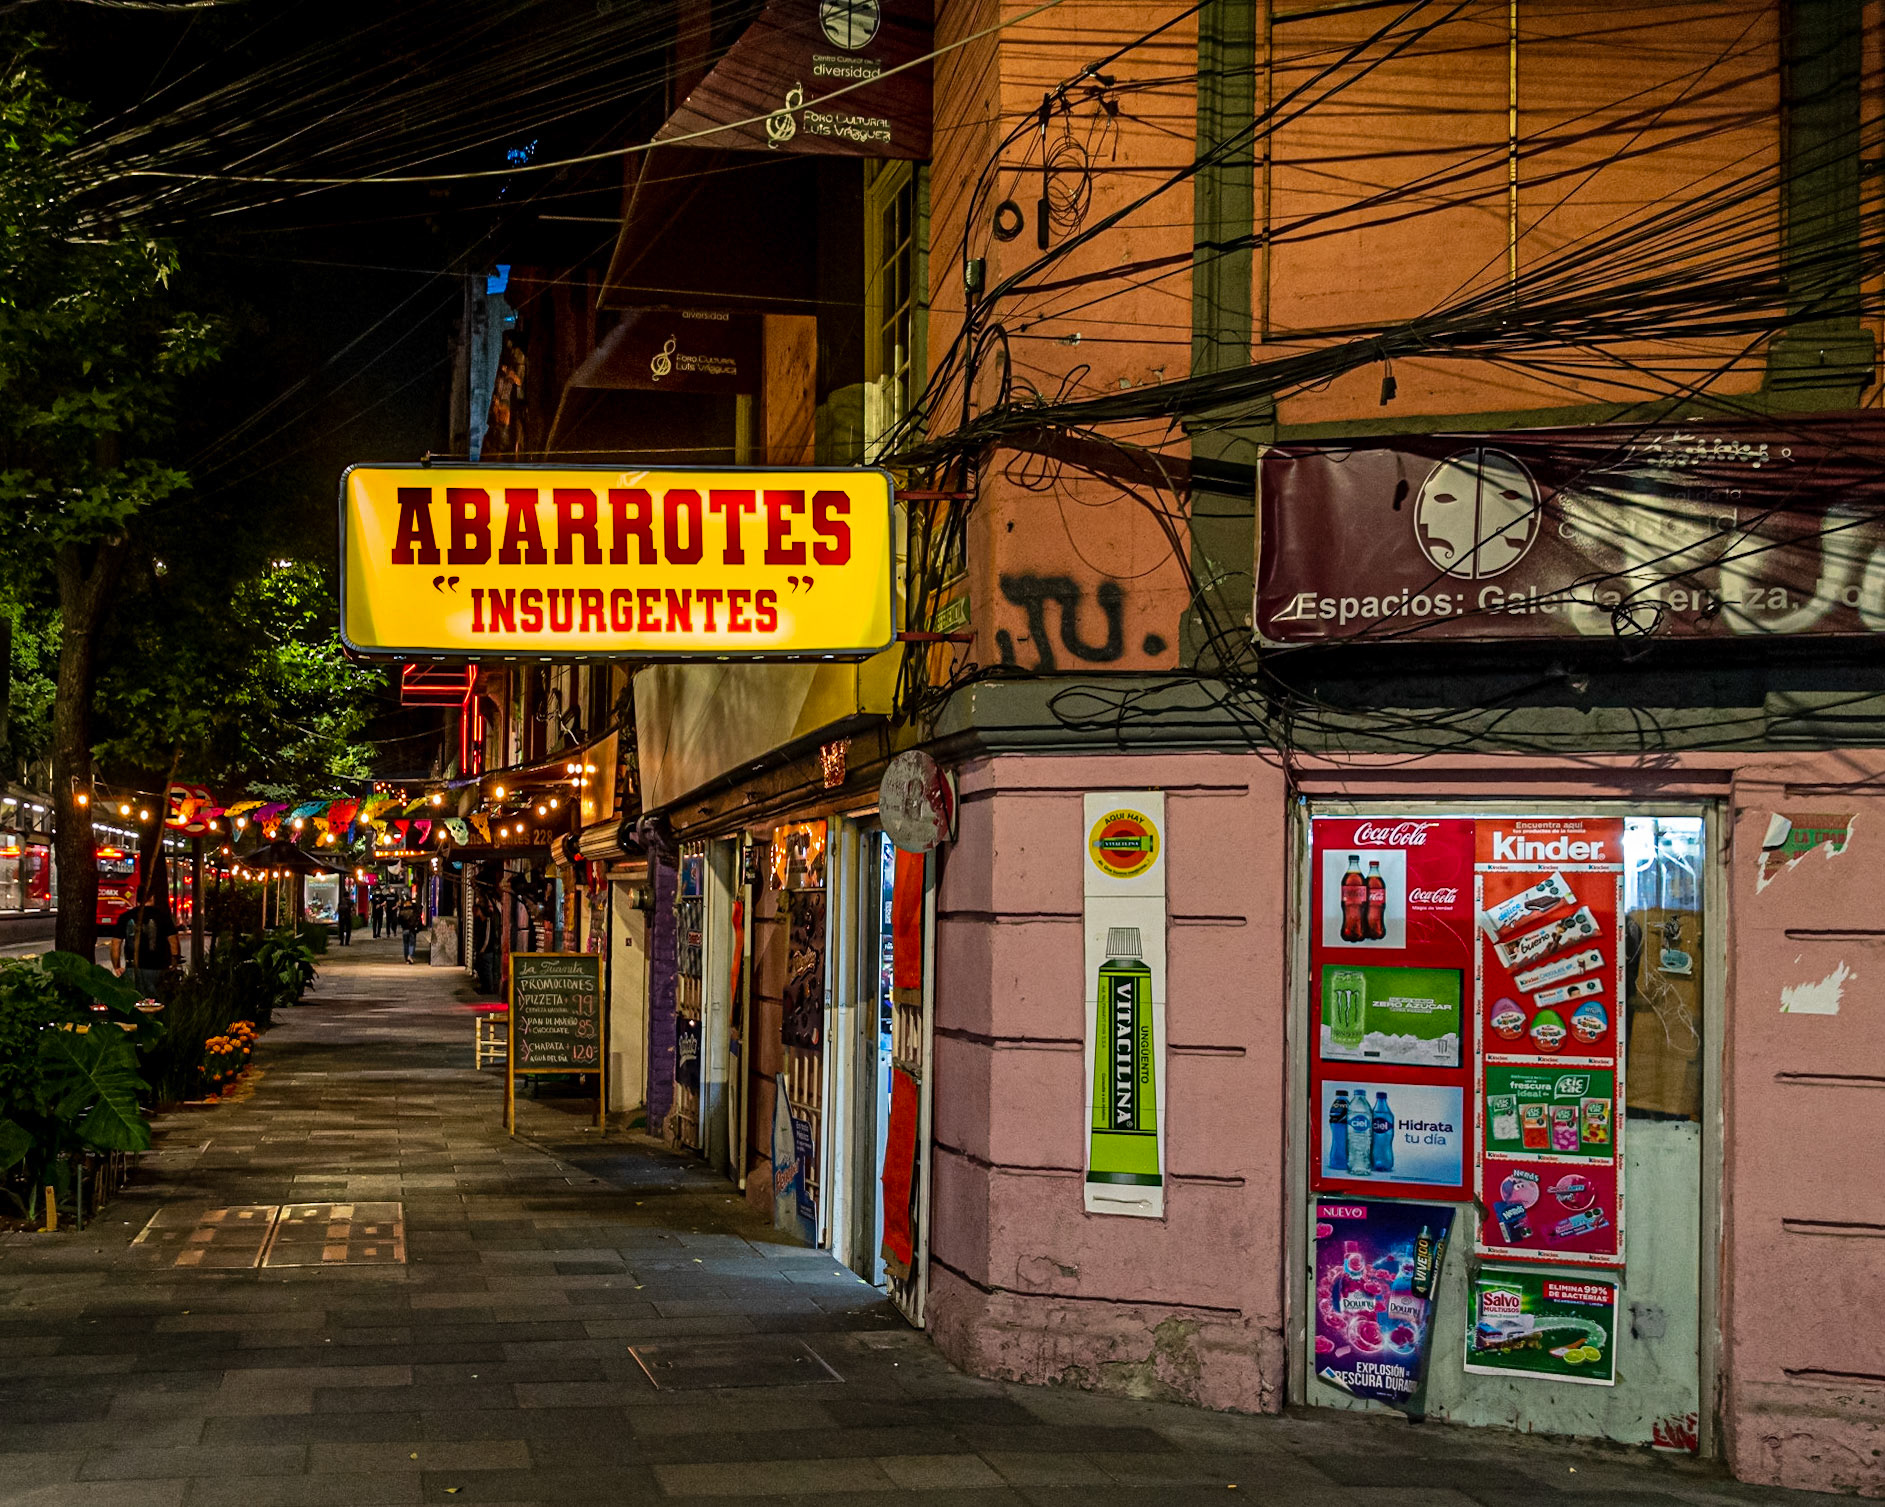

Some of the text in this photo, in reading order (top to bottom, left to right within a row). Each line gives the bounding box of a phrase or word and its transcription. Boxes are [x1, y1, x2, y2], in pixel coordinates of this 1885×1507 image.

[813, 63, 881, 79] diversidad
[390, 486, 852, 567] ABARROTES
[1295, 586, 1465, 626] Espacios:
[1104, 812, 1145, 825] AQUI HAY
[1515, 821, 1561, 829] Encuentra
[533, 828, 553, 846] 228
[1353, 821, 1440, 847] Coca-Cola
[1492, 830, 1605, 861] Kinder
[1408, 887, 1459, 904] Coca-Cola
[1520, 933, 1550, 954] bueno
[520, 978, 594, 991] PROMOCIONES
[524, 993, 594, 1015] PIZZETA 99
[532, 1026, 570, 1034] CHOCOLATE
[577, 1018, 595, 1036] 85
[528, 1042, 594, 1059] CHAPATA 120
[1116, 982, 1132, 1125] VITACILINA
[1140, 1025, 1151, 1084] UNGÜENTO
[1510, 1080, 1552, 1091] frescura
[1566, 1076, 1584, 1087] tic
[1517, 1089, 1542, 1098] ideal
[1561, 1085, 1583, 1094] tac
[1351, 1119, 1367, 1128] ciel
[1372, 1120, 1388, 1130] ciel
[1398, 1119, 1454, 1133] Hidrata
[1404, 1132, 1447, 1146] tu día
[1513, 1169, 1540, 1182] Nerds
[1323, 1206, 1363, 1218] NUEVO
[1548, 1283, 1608, 1296] ELIMINA 99%
[1343, 1298, 1375, 1310] Downy
[1483, 1292, 1519, 1308] Salvo
[1390, 1302, 1421, 1317] Downy
[1356, 1361, 1406, 1378] EXPLOSIÓN
